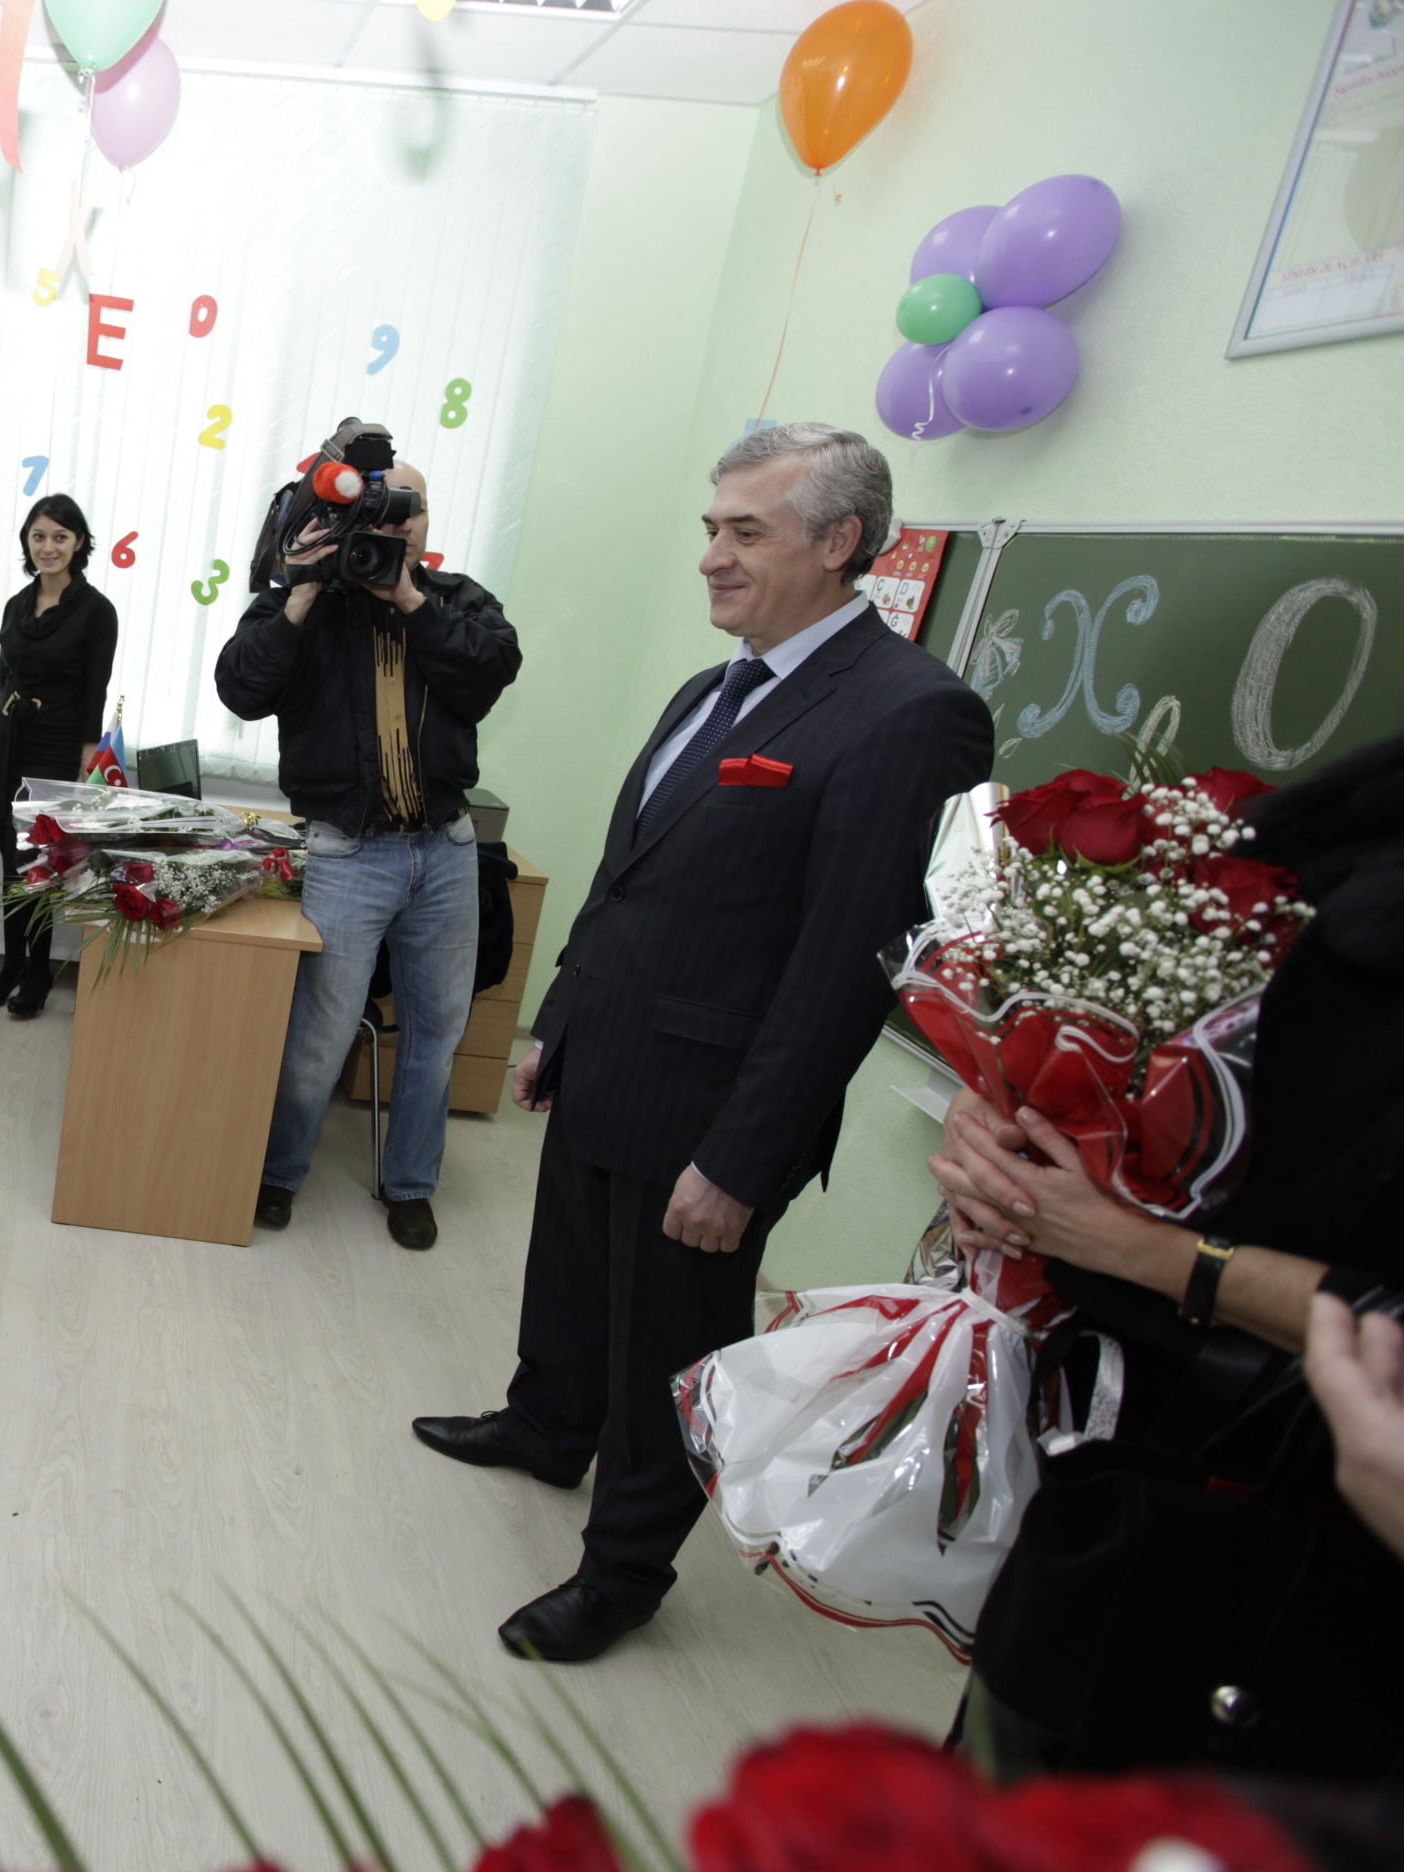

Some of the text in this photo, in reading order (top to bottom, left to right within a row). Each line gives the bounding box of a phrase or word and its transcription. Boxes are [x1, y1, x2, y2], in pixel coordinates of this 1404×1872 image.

[32, 267, 62, 307] 5
[86, 292, 135, 371] E
[366, 324, 400, 376] 9
[198, 403, 233, 451] 2
[440, 377, 473, 429] 8
[111, 530, 139, 569] 6
[190, 558, 230, 606] 3
